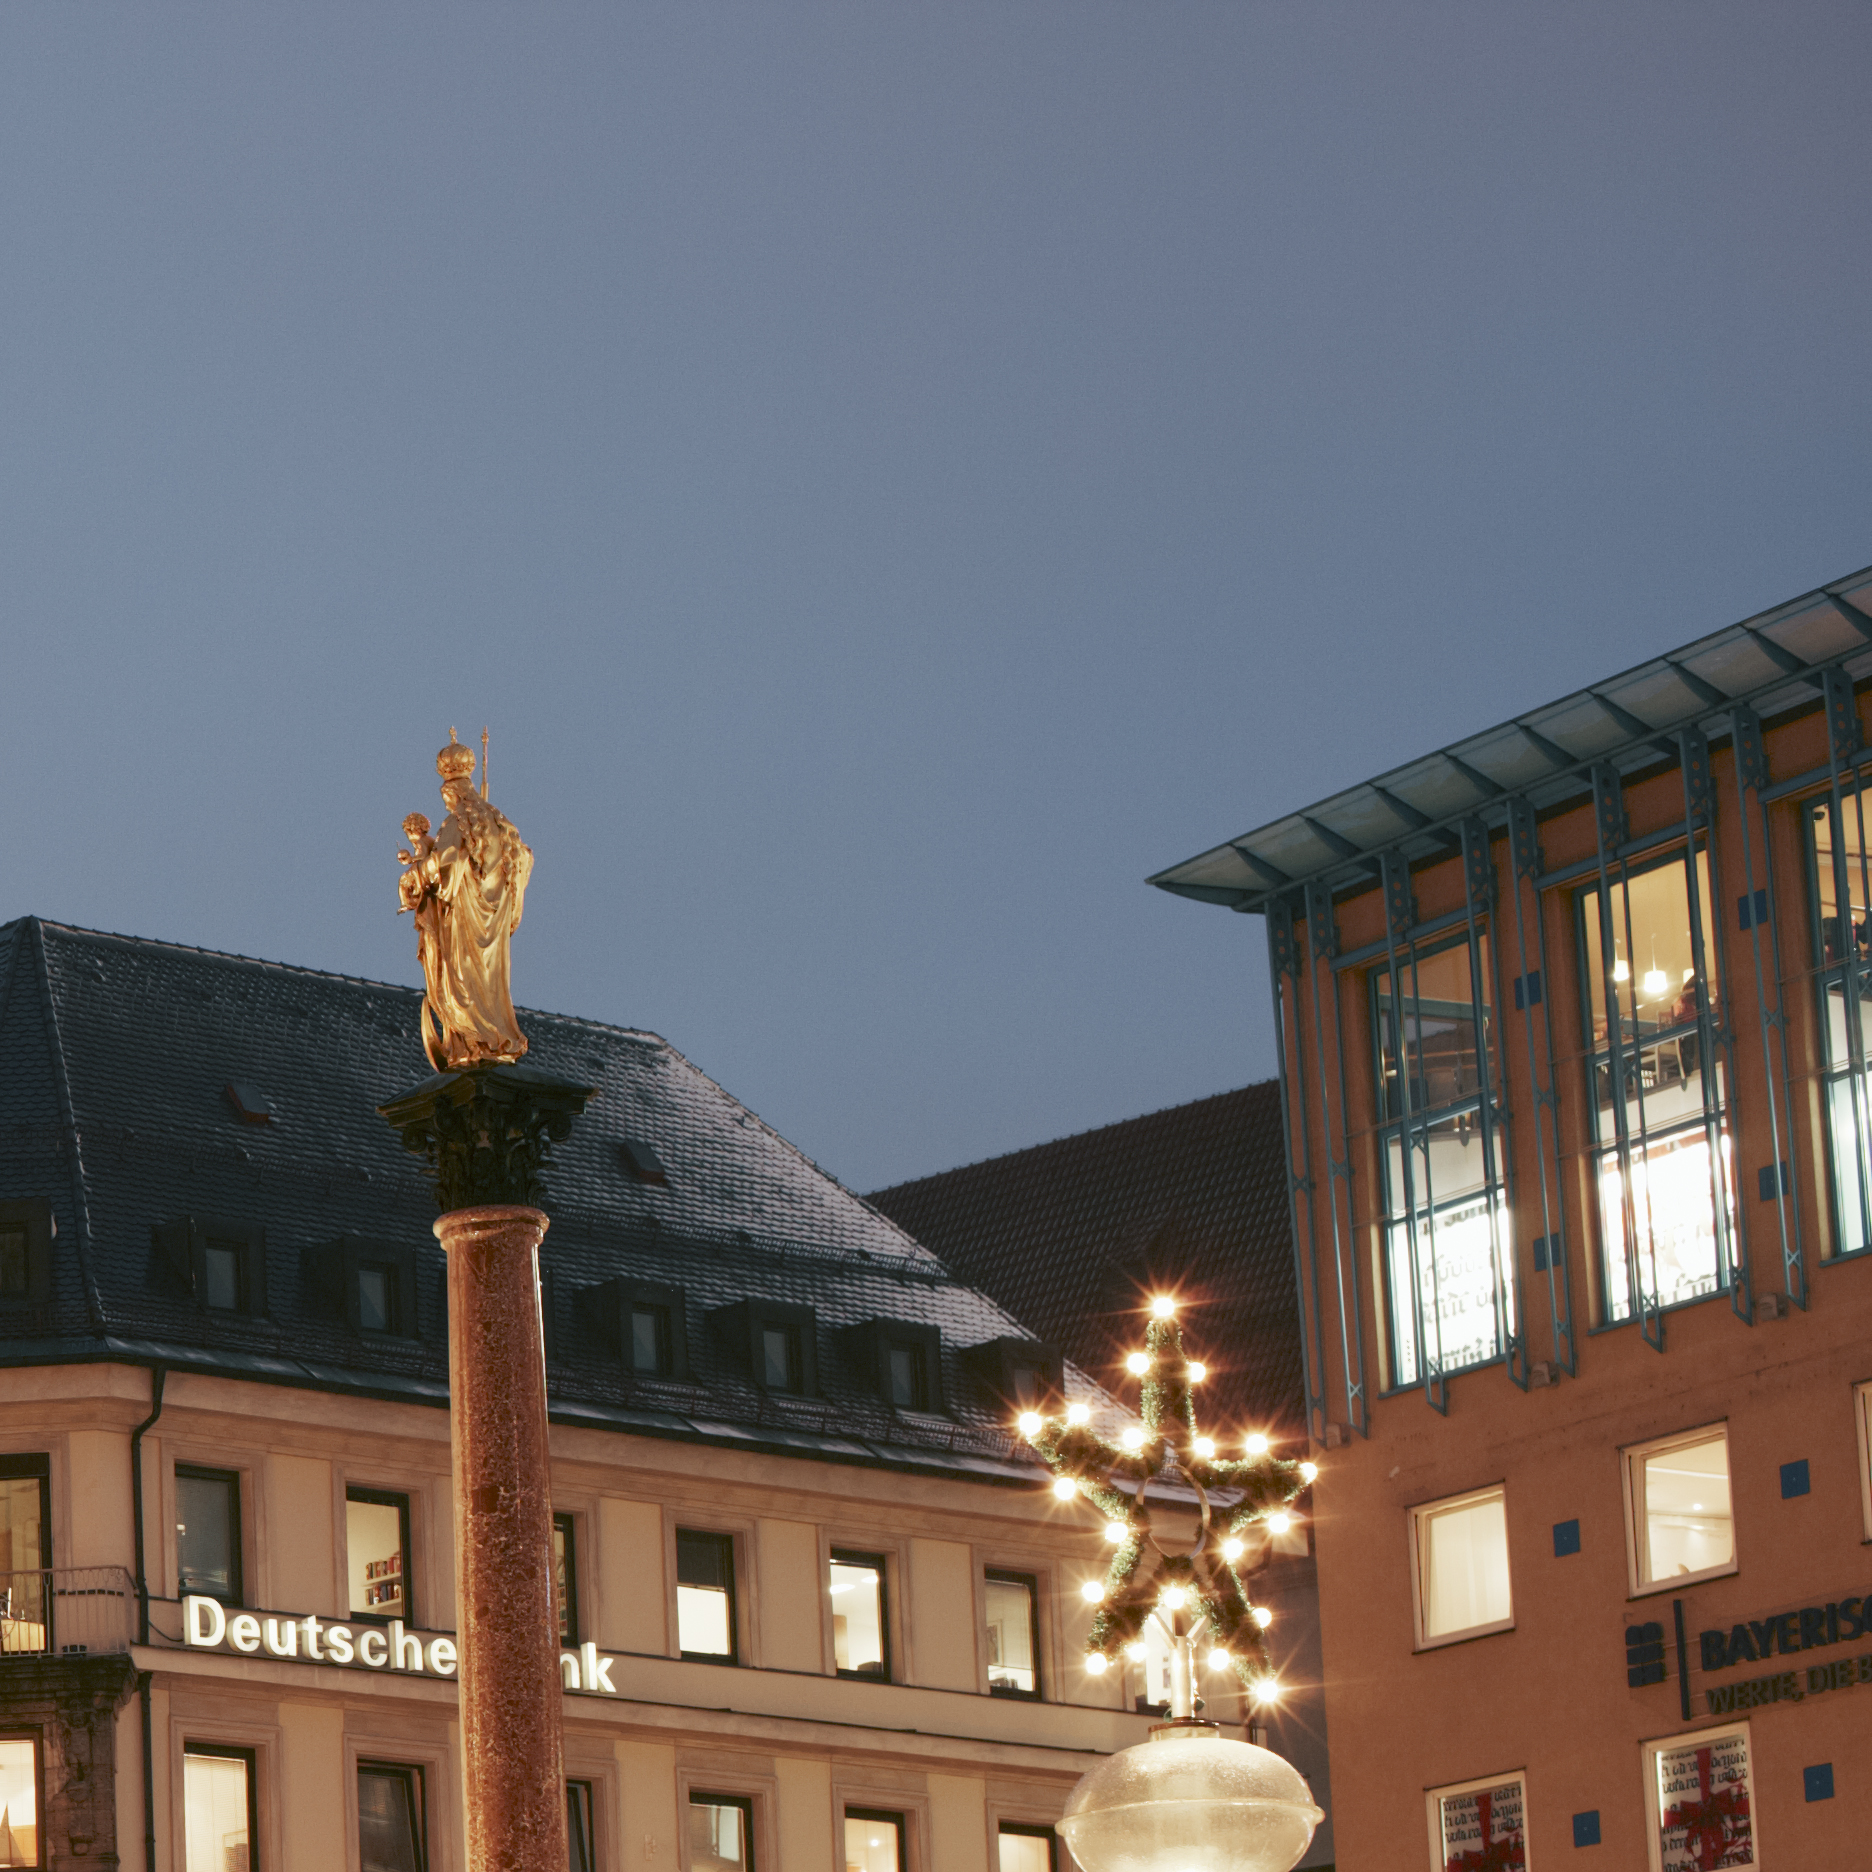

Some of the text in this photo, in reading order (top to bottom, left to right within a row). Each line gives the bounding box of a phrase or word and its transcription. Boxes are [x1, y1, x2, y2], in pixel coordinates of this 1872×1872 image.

[182, 1594, 618, 1694] Deutsche nk
[1706, 1671, 1805, 1715] WERTE,
[1806, 1658, 1855, 1695] DIE
